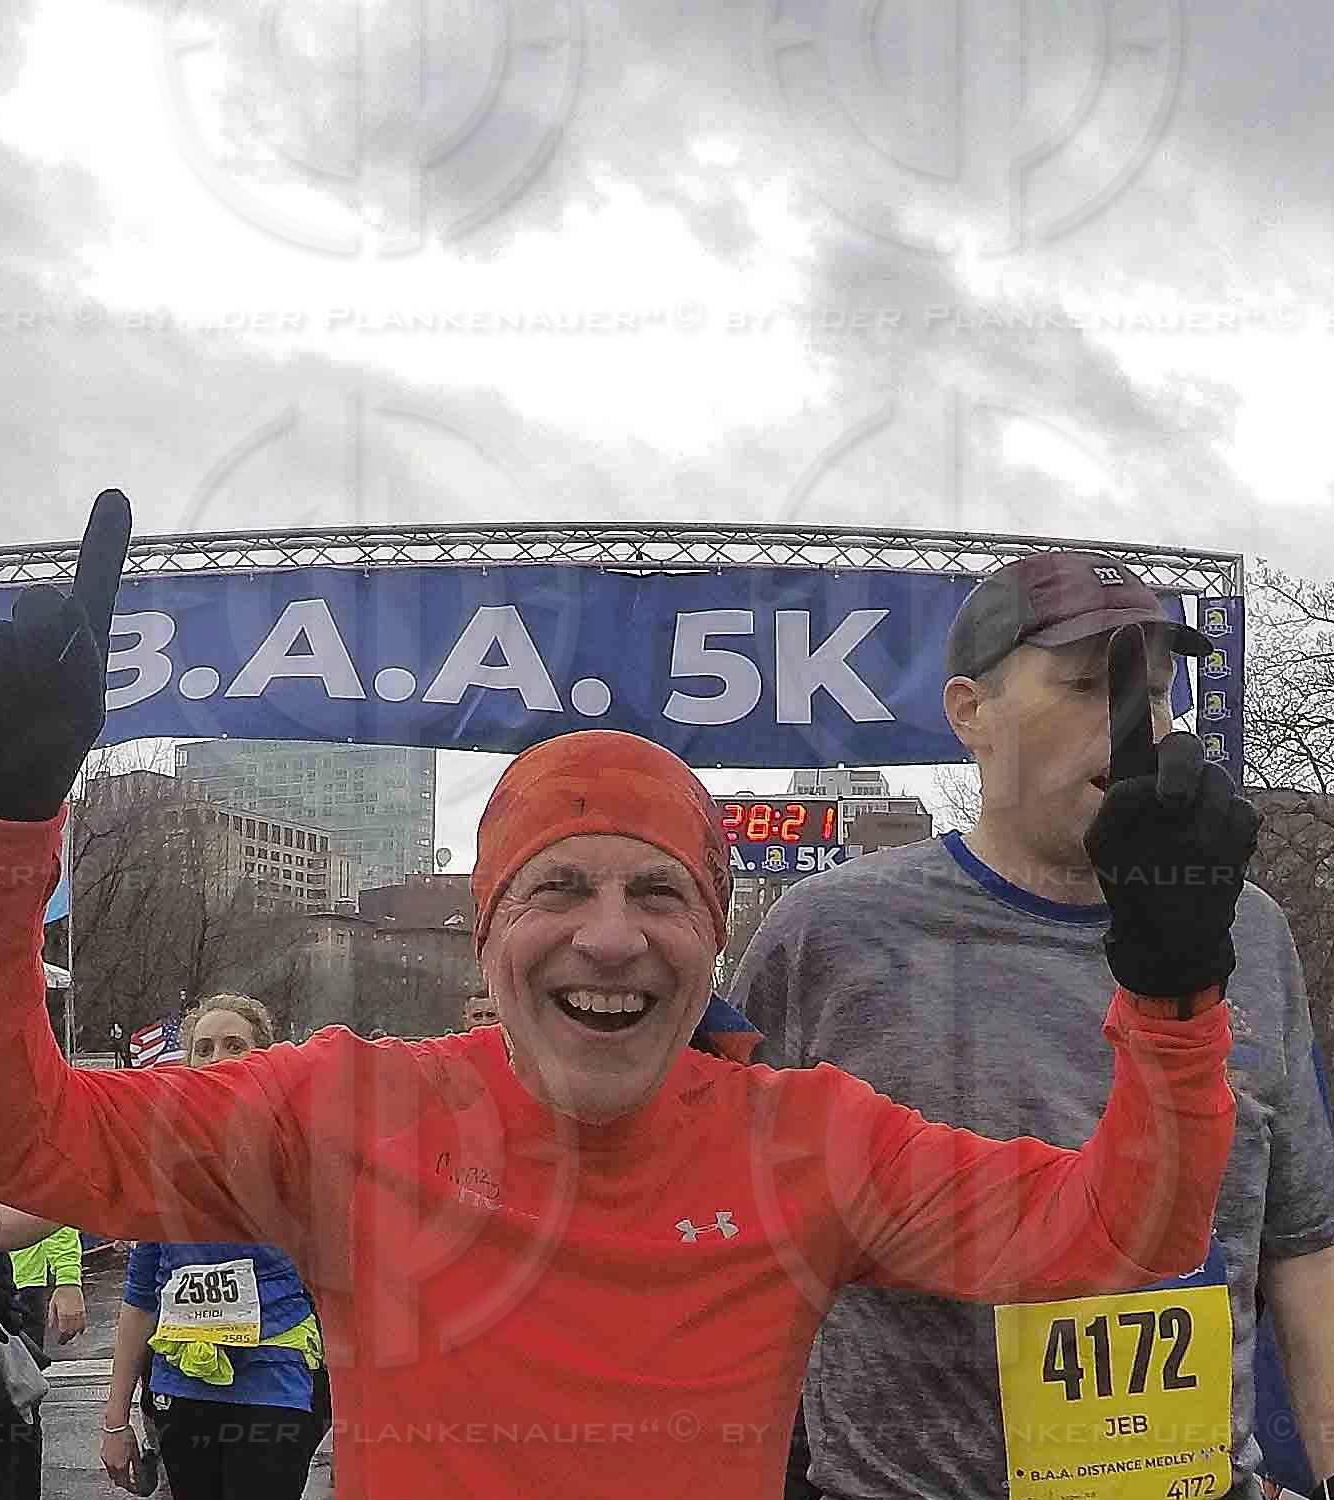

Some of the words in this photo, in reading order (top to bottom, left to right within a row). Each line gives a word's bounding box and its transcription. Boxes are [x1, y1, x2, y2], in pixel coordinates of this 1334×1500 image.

[661, 608, 897, 726] 5K
[796, 847, 843, 872] 5K
[175, 1269, 240, 1305] 2585
[1042, 1306, 1197, 1402] 4172
[1105, 1415, 1149, 1437] JEB
[1030, 1469, 1074, 1481] B.A.A.
[1076, 1458, 1143, 1478] DISTANCE
[1144, 1451, 1196, 1469] MEDLEY
[1166, 1473, 1216, 1500] 4172
